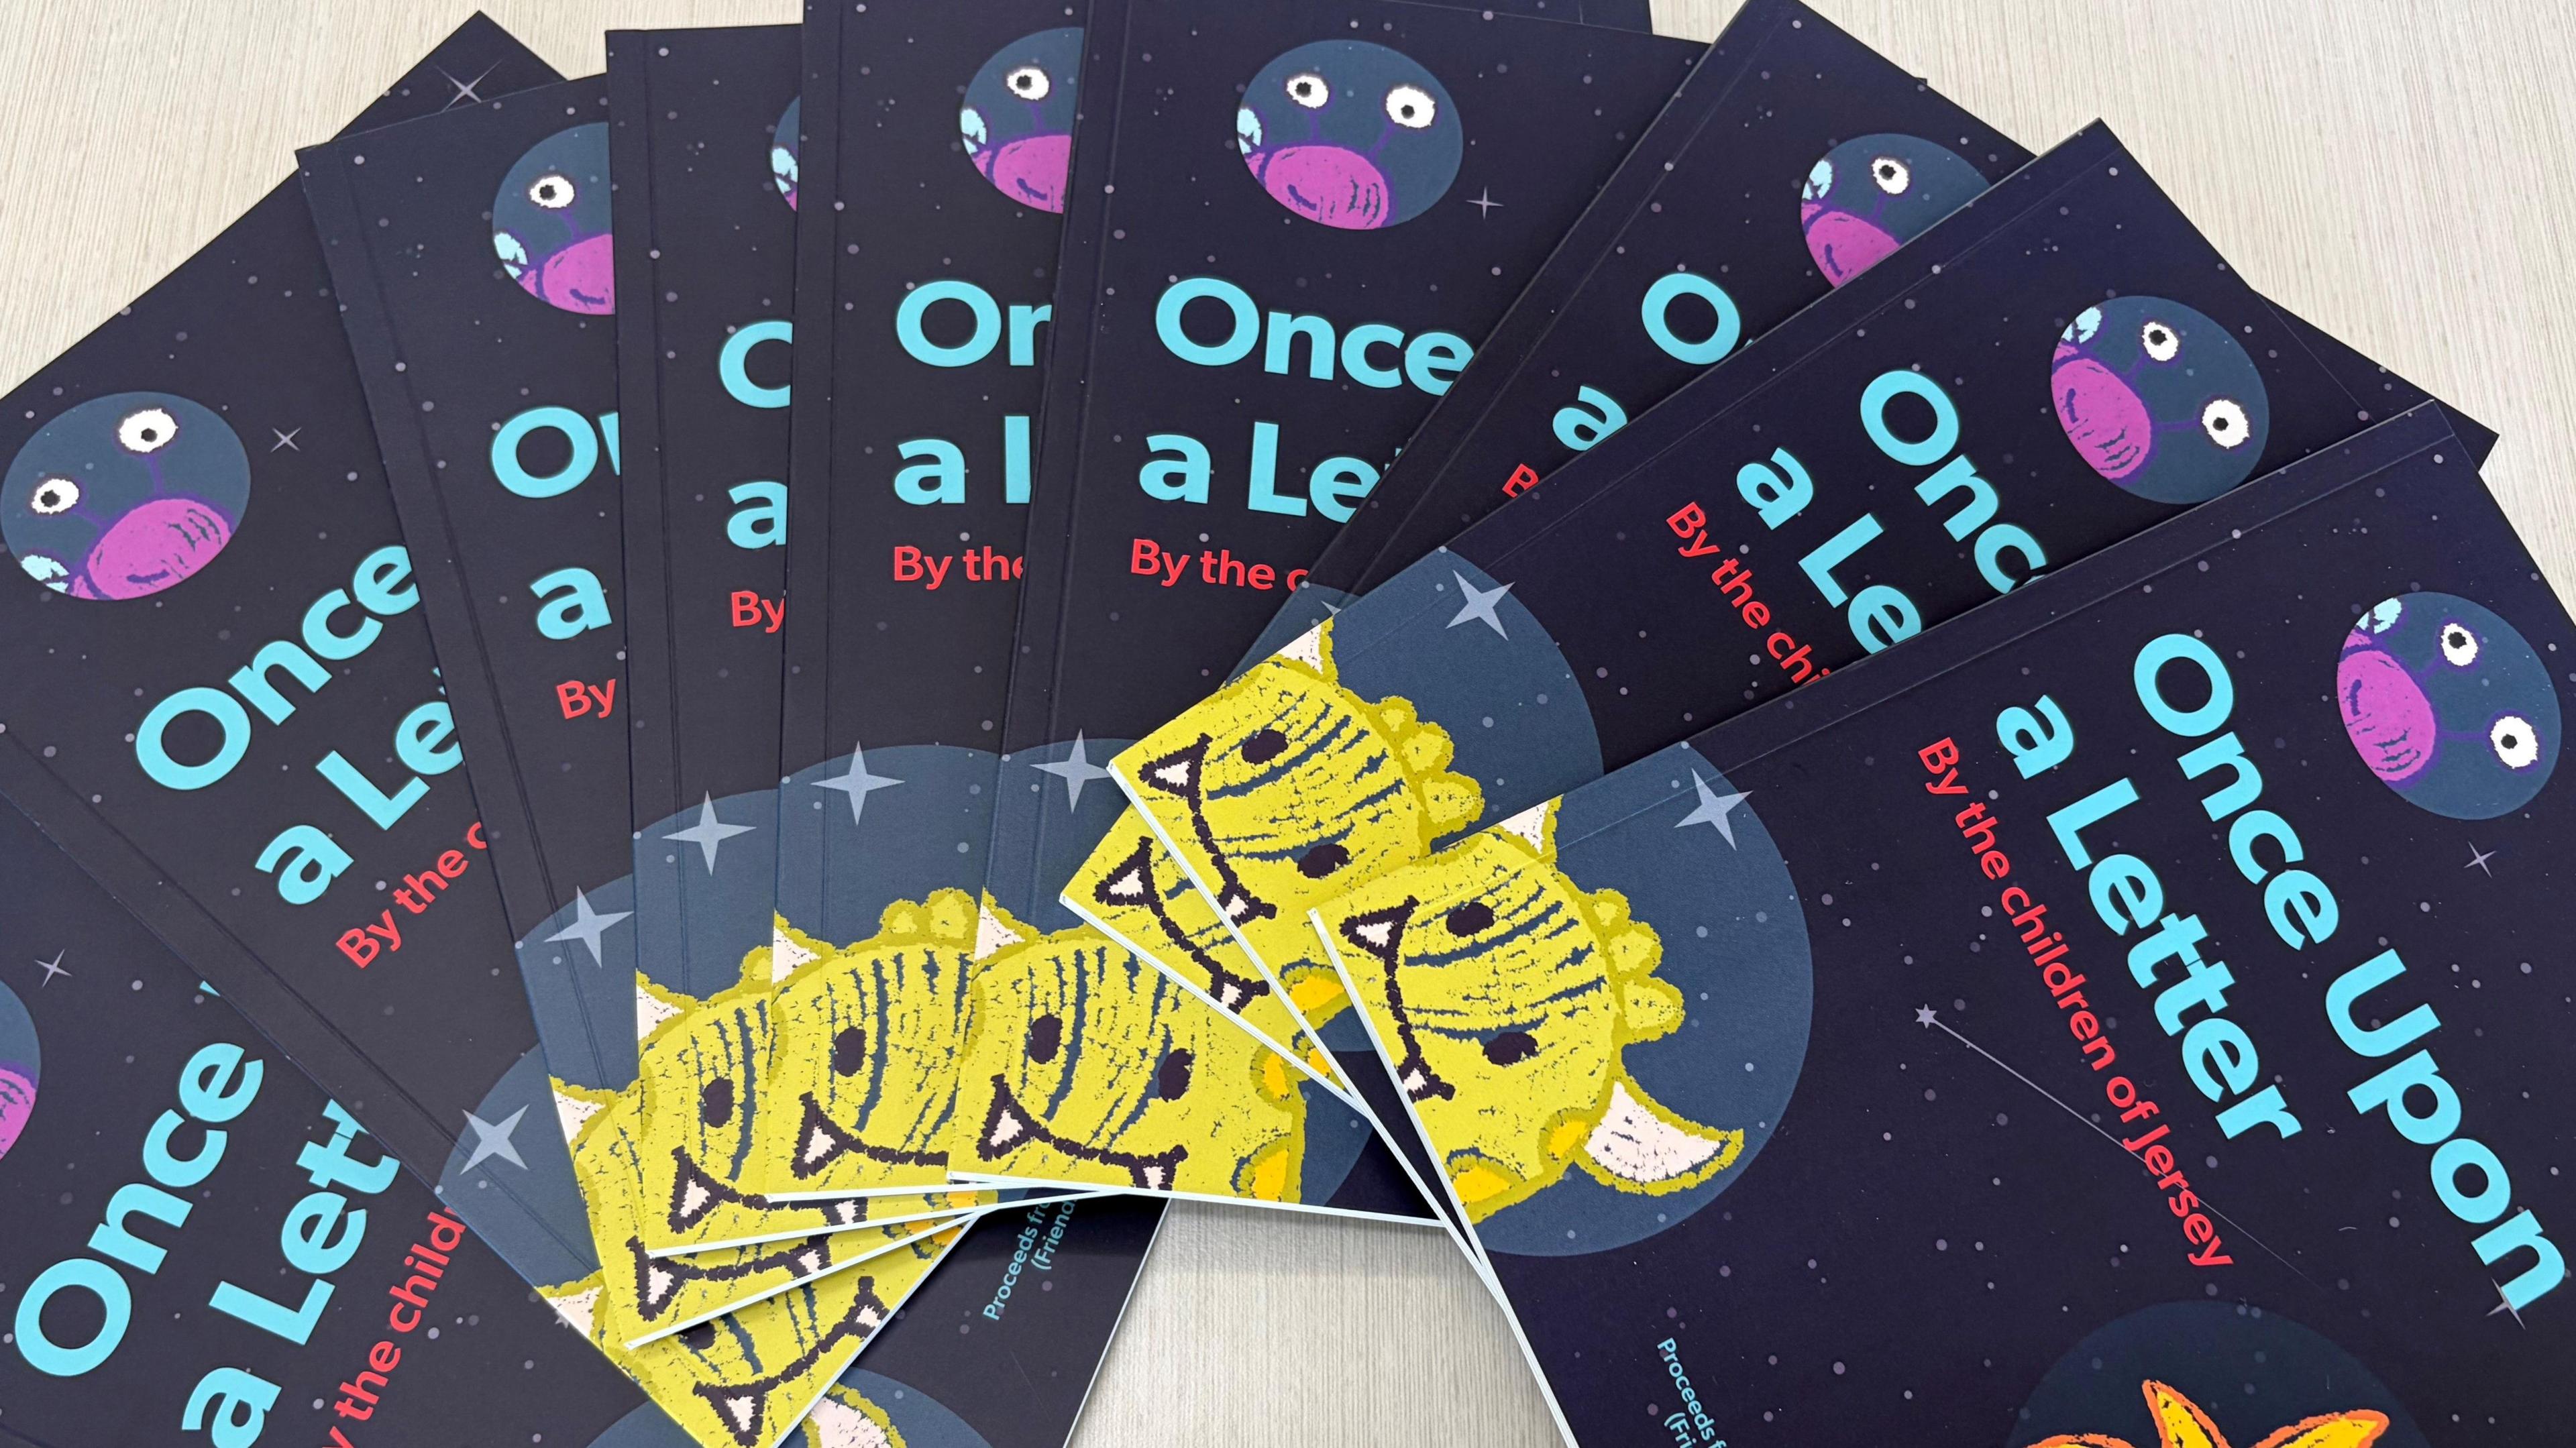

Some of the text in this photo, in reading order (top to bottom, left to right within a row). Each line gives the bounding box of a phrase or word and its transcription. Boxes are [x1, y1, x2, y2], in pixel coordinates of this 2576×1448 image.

[1155, 277, 1474, 396] Once
[1552, 385, 1627, 451] a
[727, 480, 788, 549] a
[894, 439, 967, 506] a
[1138, 421, 1402, 523] a Le
[1736, 447, 1814, 531] a
[1860, 370, 2047, 594] Onc
[530, 567, 612, 640] a
[731, 590, 785, 634] By
[894, 546, 953, 591] By
[1130, 538, 1191, 588] By
[1199, 550, 1276, 590] the
[1666, 501, 1721, 558] By
[1711, 559, 1771, 629] the
[135, 545, 421, 791] Once
[555, 678, 616, 720] By
[254, 667, 464, 905] a Le
[336, 911, 402, 969] By
[392, 849, 469, 915] the
[1996, 695, 2302, 1139] a Letter
[1919, 737, 2233, 1266] By the children of Jersey
[2133, 633, 2566, 1310] Once Upon
[14, 1042, 264, 1377] Once
[982, 1226, 1038, 1321] Proceeds
[180, 1366, 282, 1448] a
[334, 1341, 402, 1421] the
[1657, 1337, 1715, 1441] Proceeds
